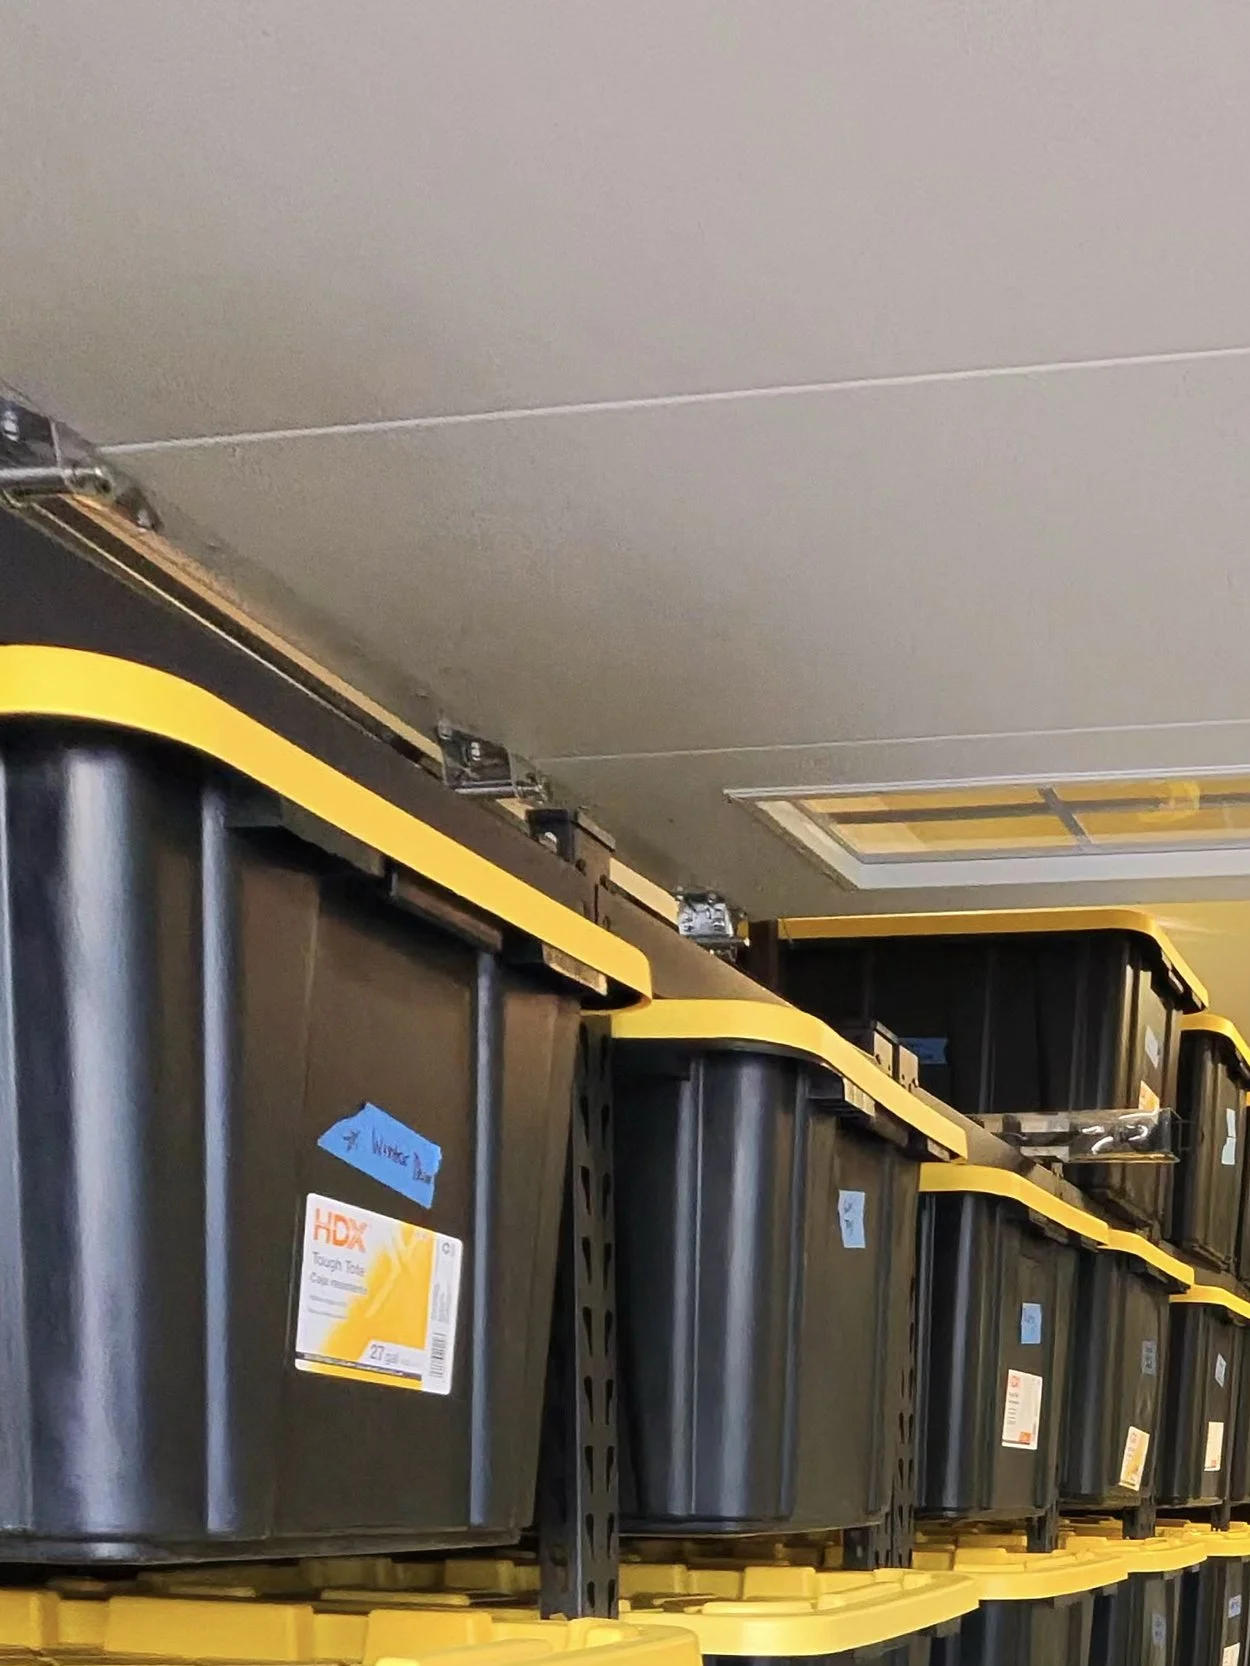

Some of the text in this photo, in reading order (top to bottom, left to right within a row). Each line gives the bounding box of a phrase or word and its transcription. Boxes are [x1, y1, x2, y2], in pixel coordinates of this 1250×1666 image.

[313, 1208, 367, 1253] HDX
[312, 1251, 365, 1277] Tough Tote
[370, 1344, 385, 1360] 27
